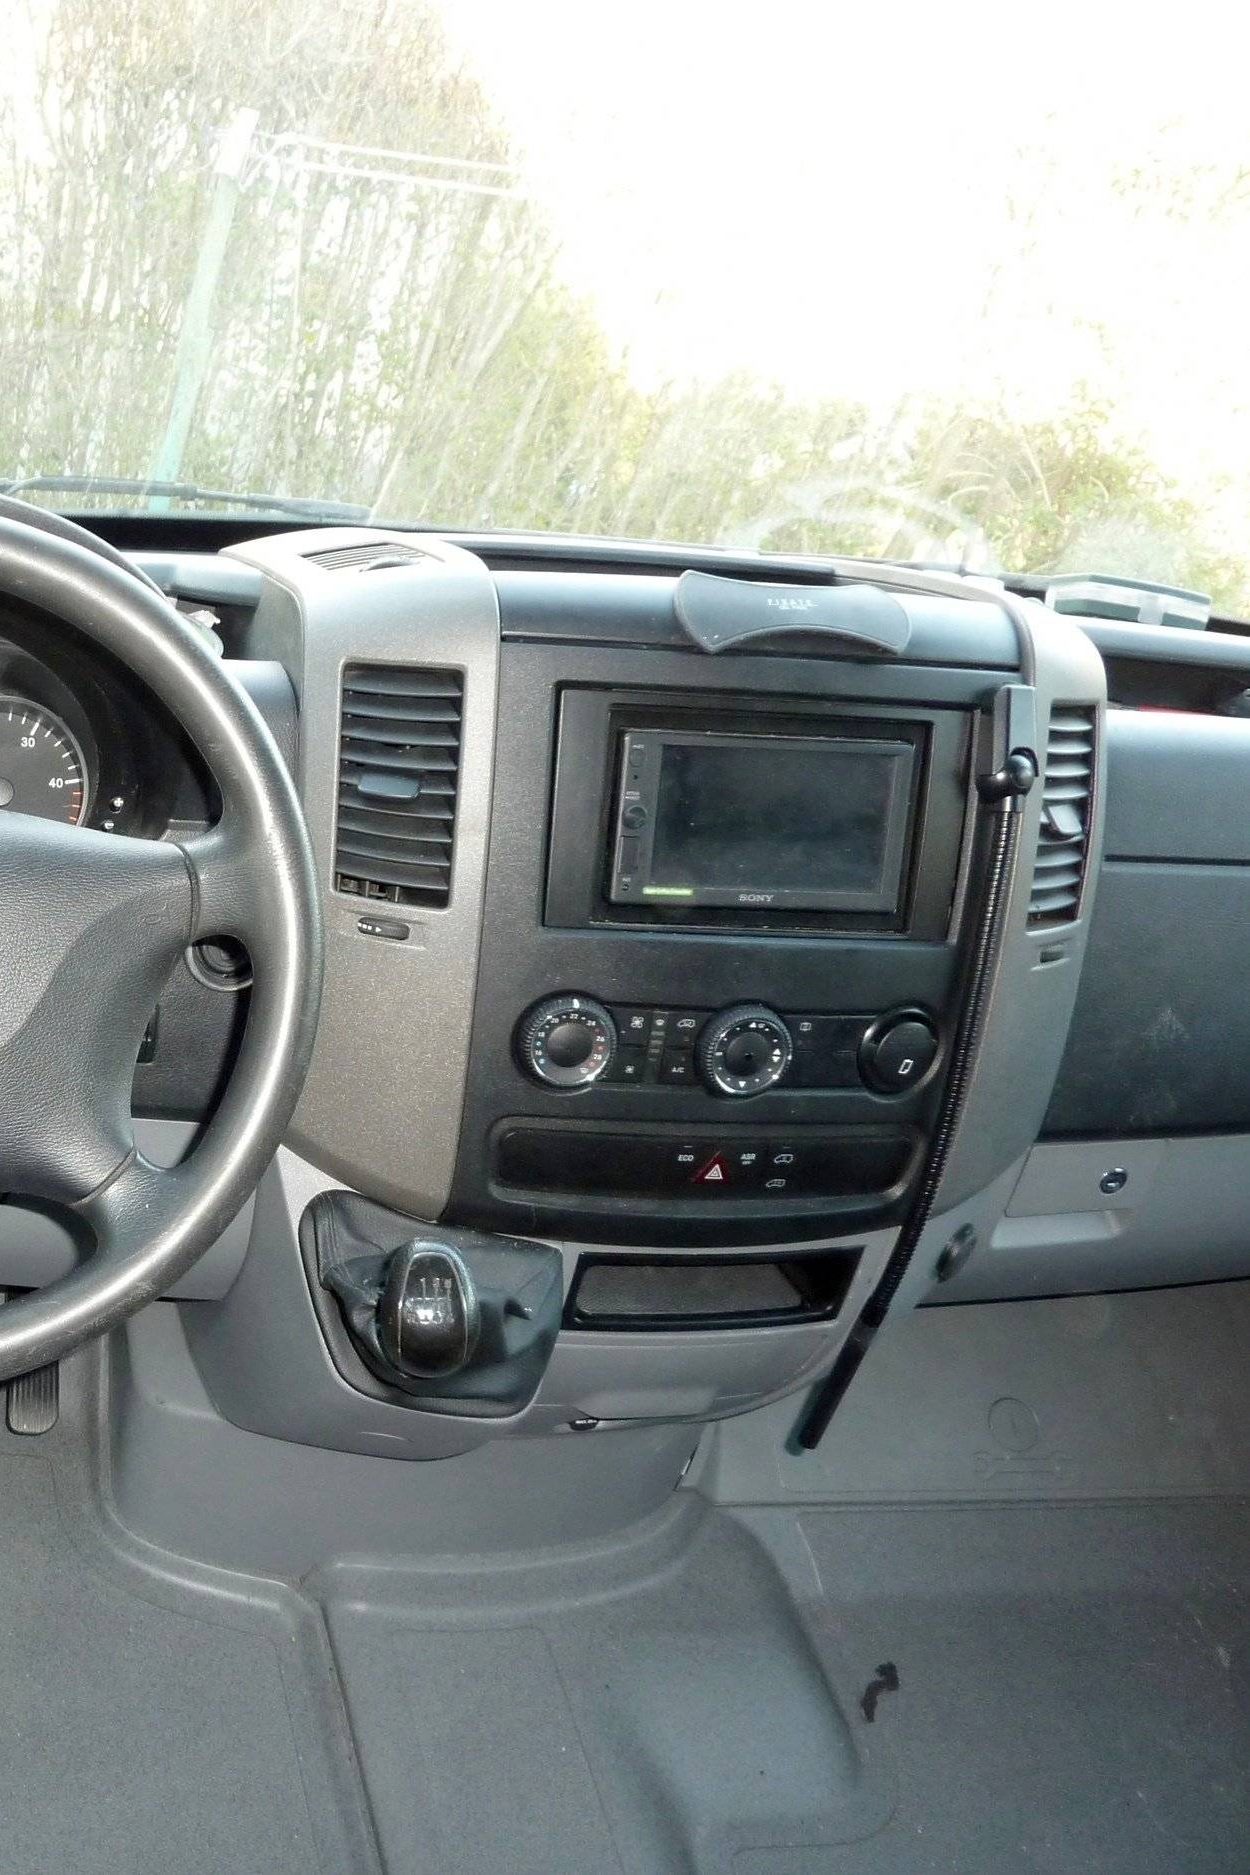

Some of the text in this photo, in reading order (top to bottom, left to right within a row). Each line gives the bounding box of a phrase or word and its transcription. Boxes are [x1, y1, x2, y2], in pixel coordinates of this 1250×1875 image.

[20, 737, 36, 748] 30
[48, 777, 63, 788] 40
[739, 893, 775, 902] SONY
[677, 1154, 695, 1162] ECO
[740, 1153, 756, 1161] ASR
